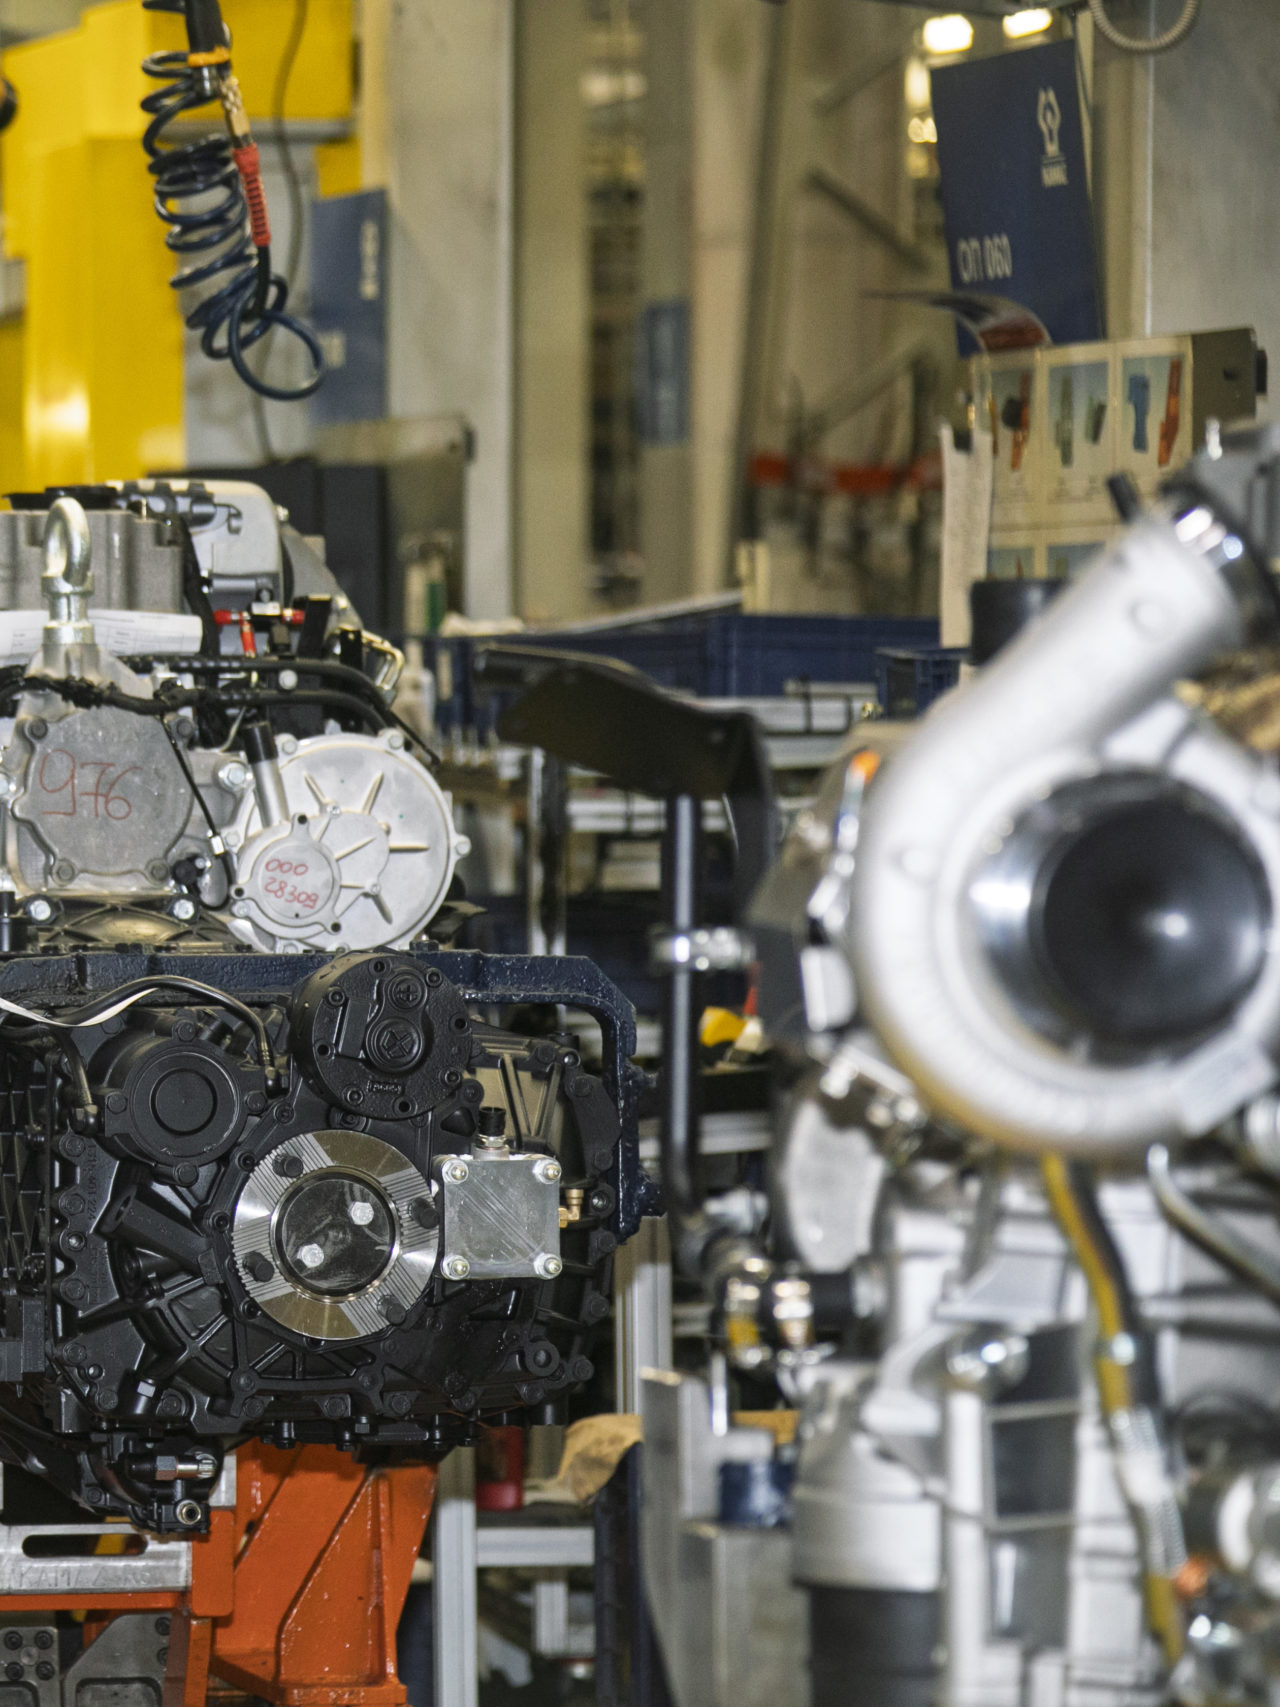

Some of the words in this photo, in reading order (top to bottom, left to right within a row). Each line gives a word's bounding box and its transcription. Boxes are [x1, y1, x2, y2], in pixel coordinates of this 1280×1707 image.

[39, 748, 144, 821] 976
[265, 858, 309, 876] 000
[264, 876, 319, 909] 28309
